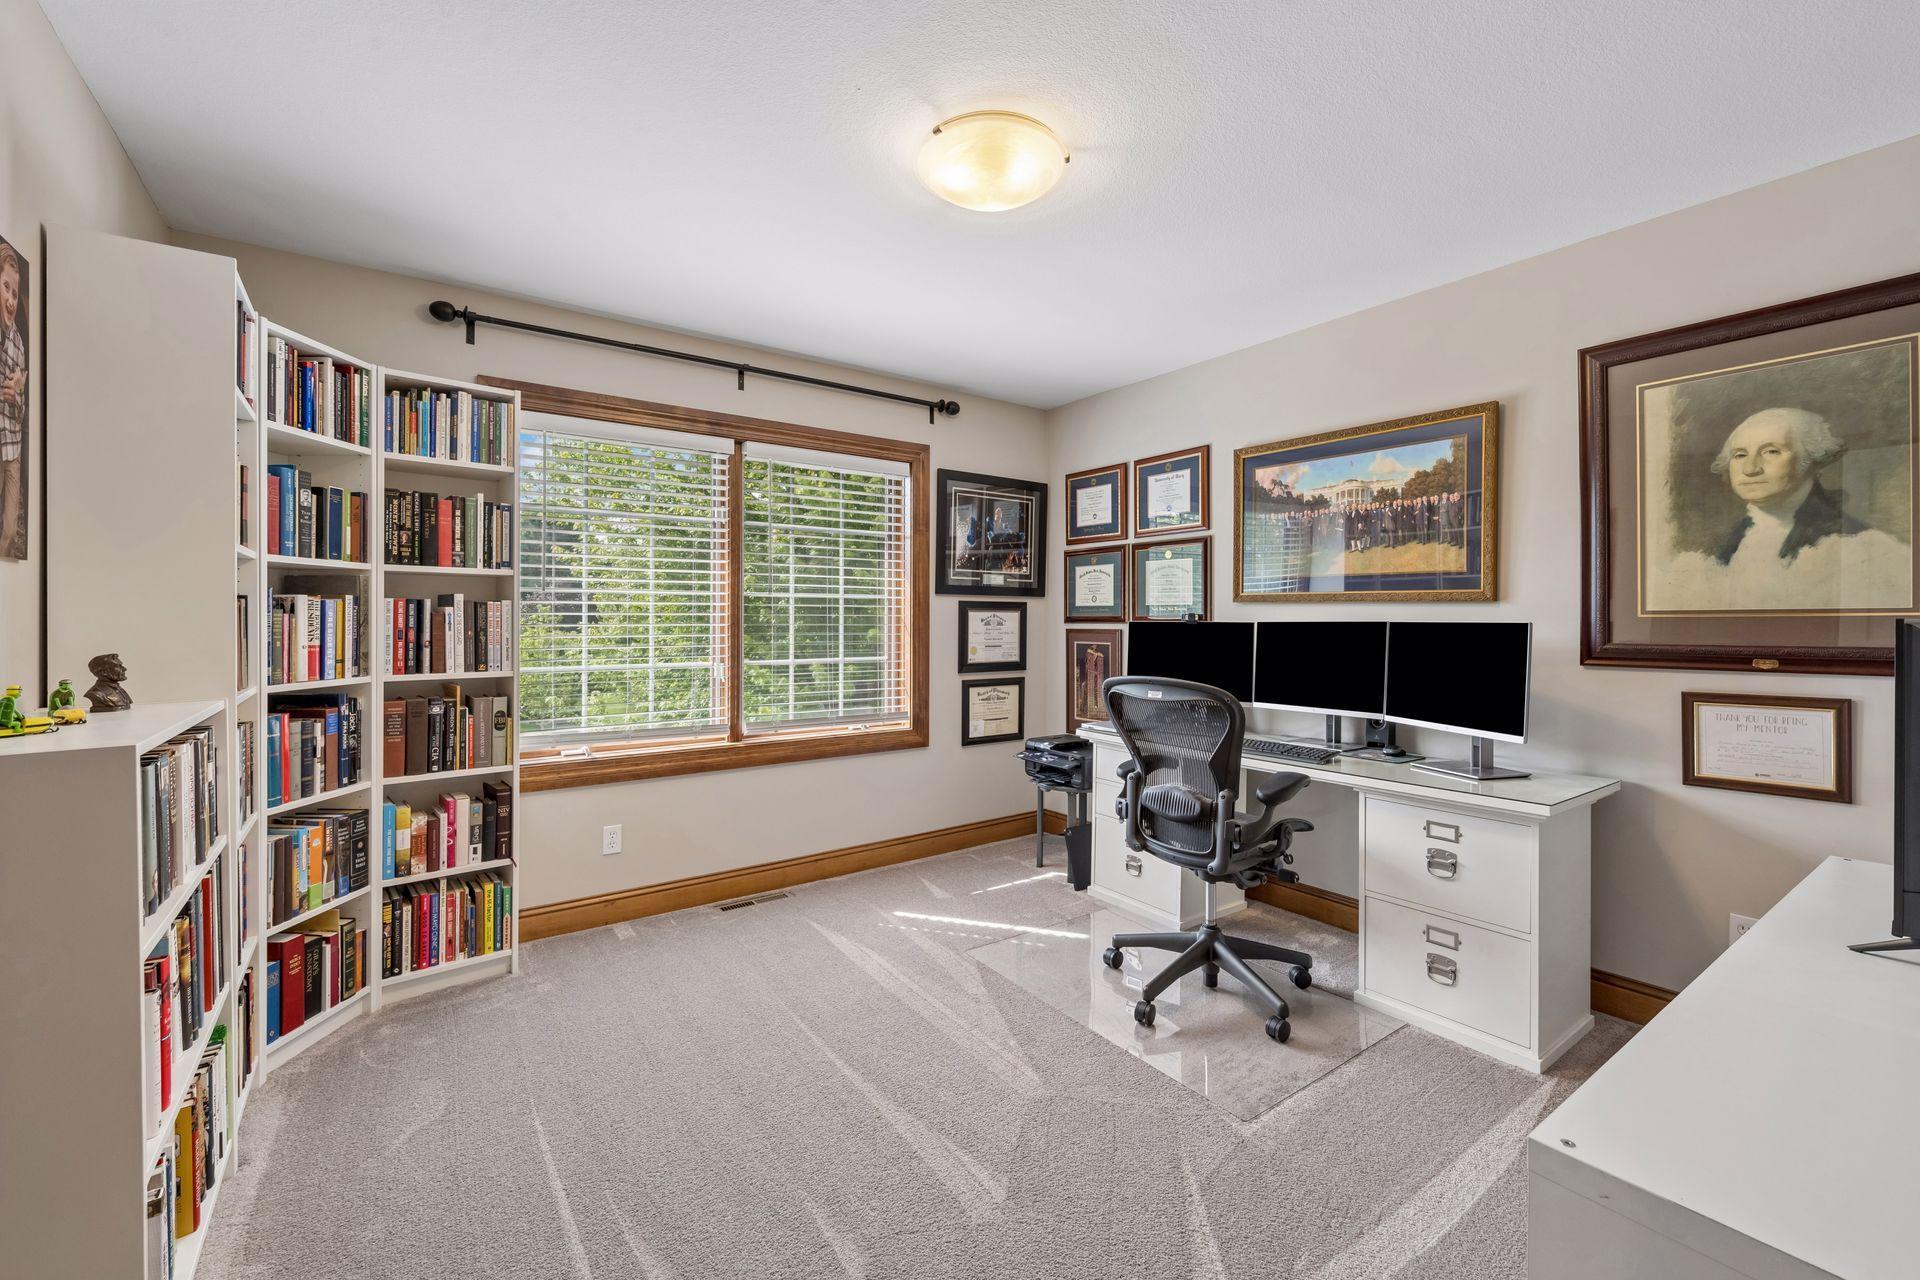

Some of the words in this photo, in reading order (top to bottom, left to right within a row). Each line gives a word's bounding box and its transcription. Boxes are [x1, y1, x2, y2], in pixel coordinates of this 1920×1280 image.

[1715, 713, 1739, 722] THANK
[1744, 714, 1760, 723] YOU
[1764, 715, 1777, 724] FOR
[1782, 716, 1808, 726] BEING
[1736, 724, 1748, 732] MY
[1754, 725, 1788, 734] MENTOR
[383, 905, 392, 924] TRUMP
